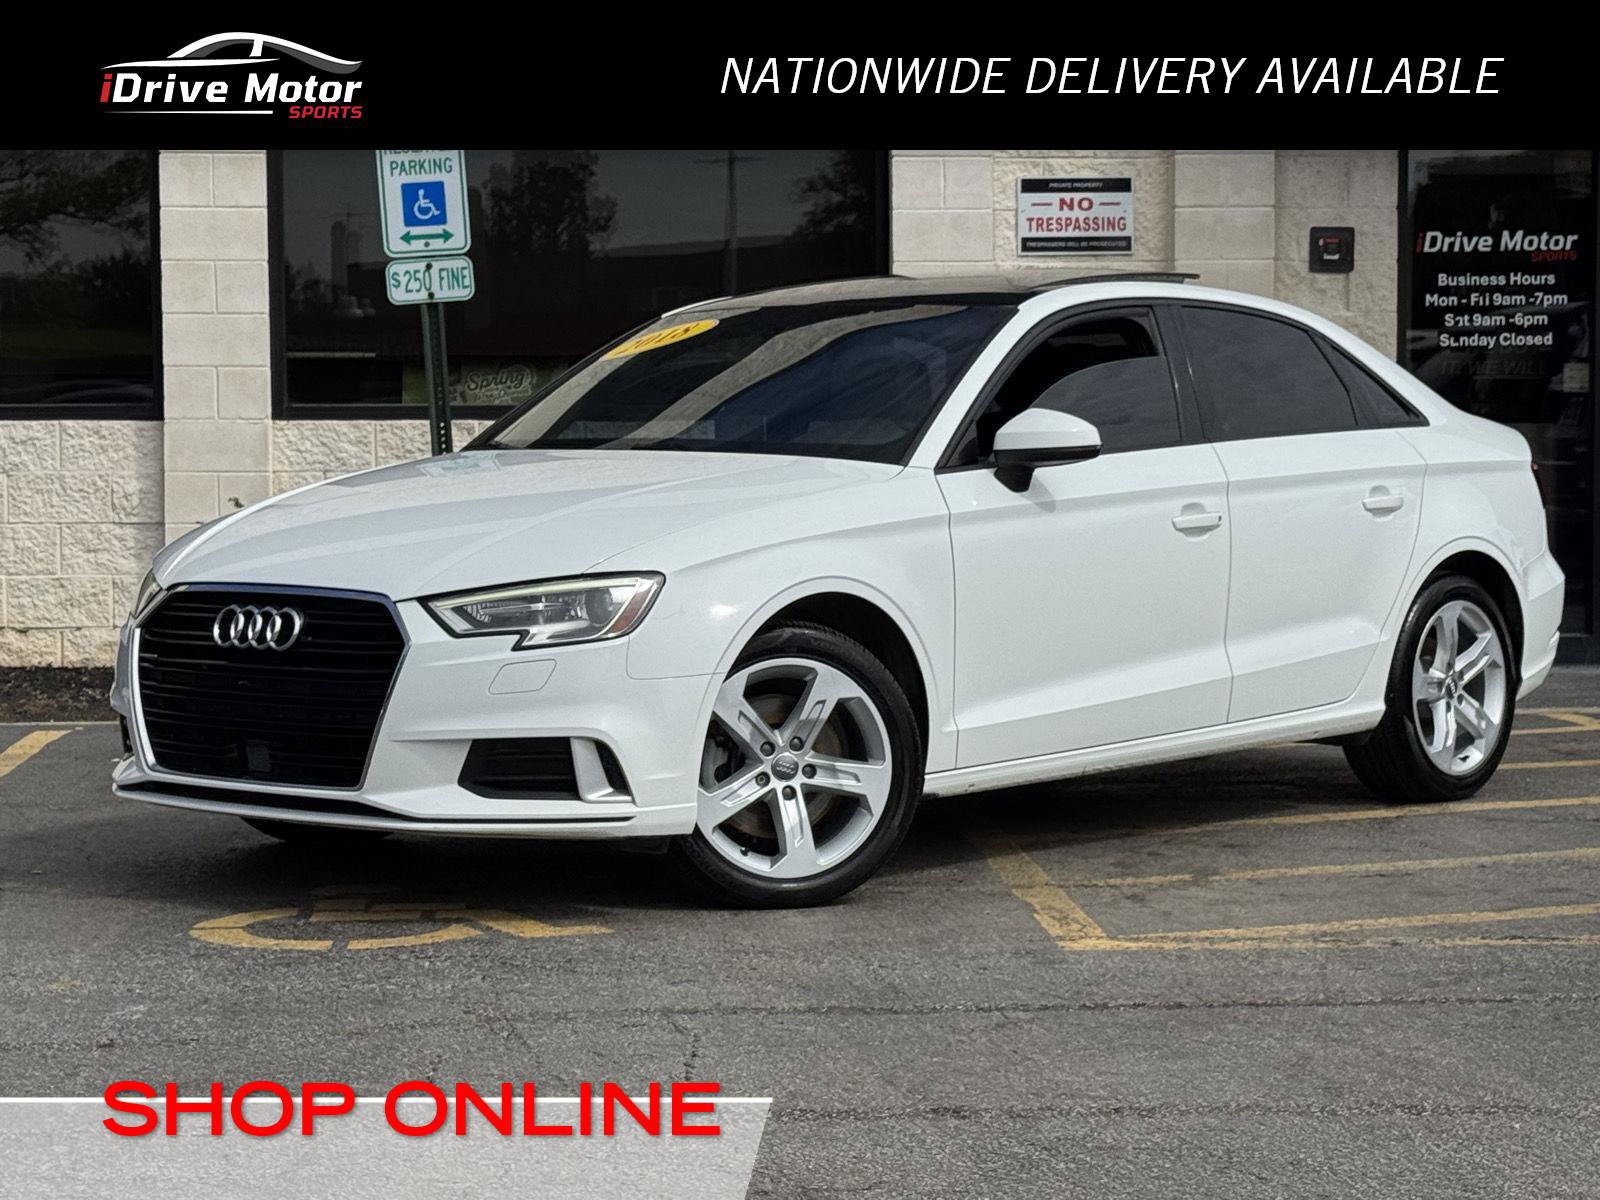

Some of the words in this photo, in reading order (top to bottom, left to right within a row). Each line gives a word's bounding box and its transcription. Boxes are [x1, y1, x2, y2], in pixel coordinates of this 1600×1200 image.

[389, 157, 453, 176] PARKING
[1059, 197, 1094, 211] NO
[1026, 216, 1127, 232] TRESPASSING
[1416, 231, 1493, 253] iDrive
[1500, 229, 1578, 251] Motor
[1530, 251, 1578, 262] SPORTS
[438, 266, 470, 291] FINE
[1438, 272, 1506, 287] Business
[1510, 272, 1556, 286] Hours
[1425, 293, 1458, 307] Mon
[1492, 292, 1526, 306] 9am
[1472, 313, 1506, 327] 9am
[1499, 332, 1554, 346] Closed
[466, 370, 526, 392] Spring
